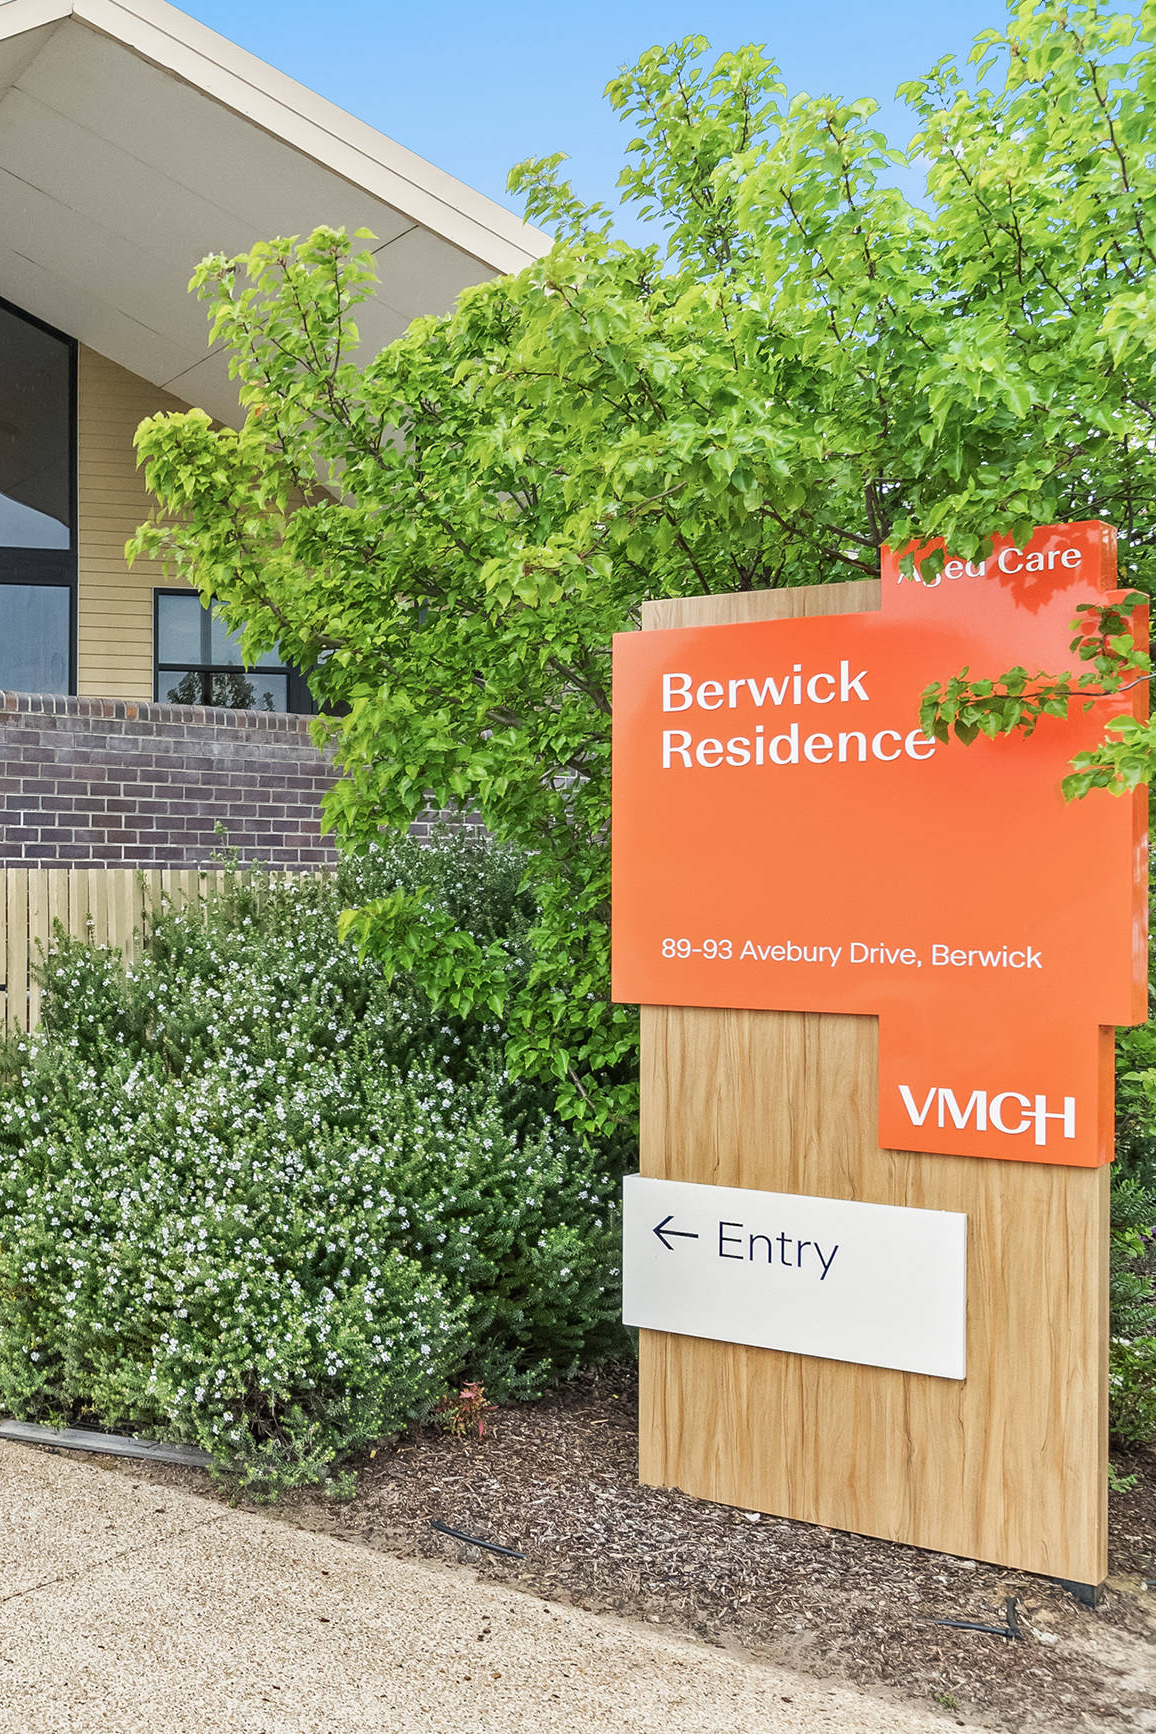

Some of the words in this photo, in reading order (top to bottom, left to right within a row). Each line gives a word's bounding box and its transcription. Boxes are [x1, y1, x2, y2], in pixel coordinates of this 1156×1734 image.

[896, 559, 987, 588] ed
[997, 547, 1083, 575] Care
[661, 660, 871, 713] Berwick
[661, 722, 937, 769] Residence
[660, 937, 734, 961] 89-93
[738, 940, 844, 968] Avebury
[849, 942, 923, 968] Drive,
[930, 944, 1044, 970] Berwick
[897, 1083, 1077, 1147] VMCH
[717, 1220, 840, 1281] Entry
